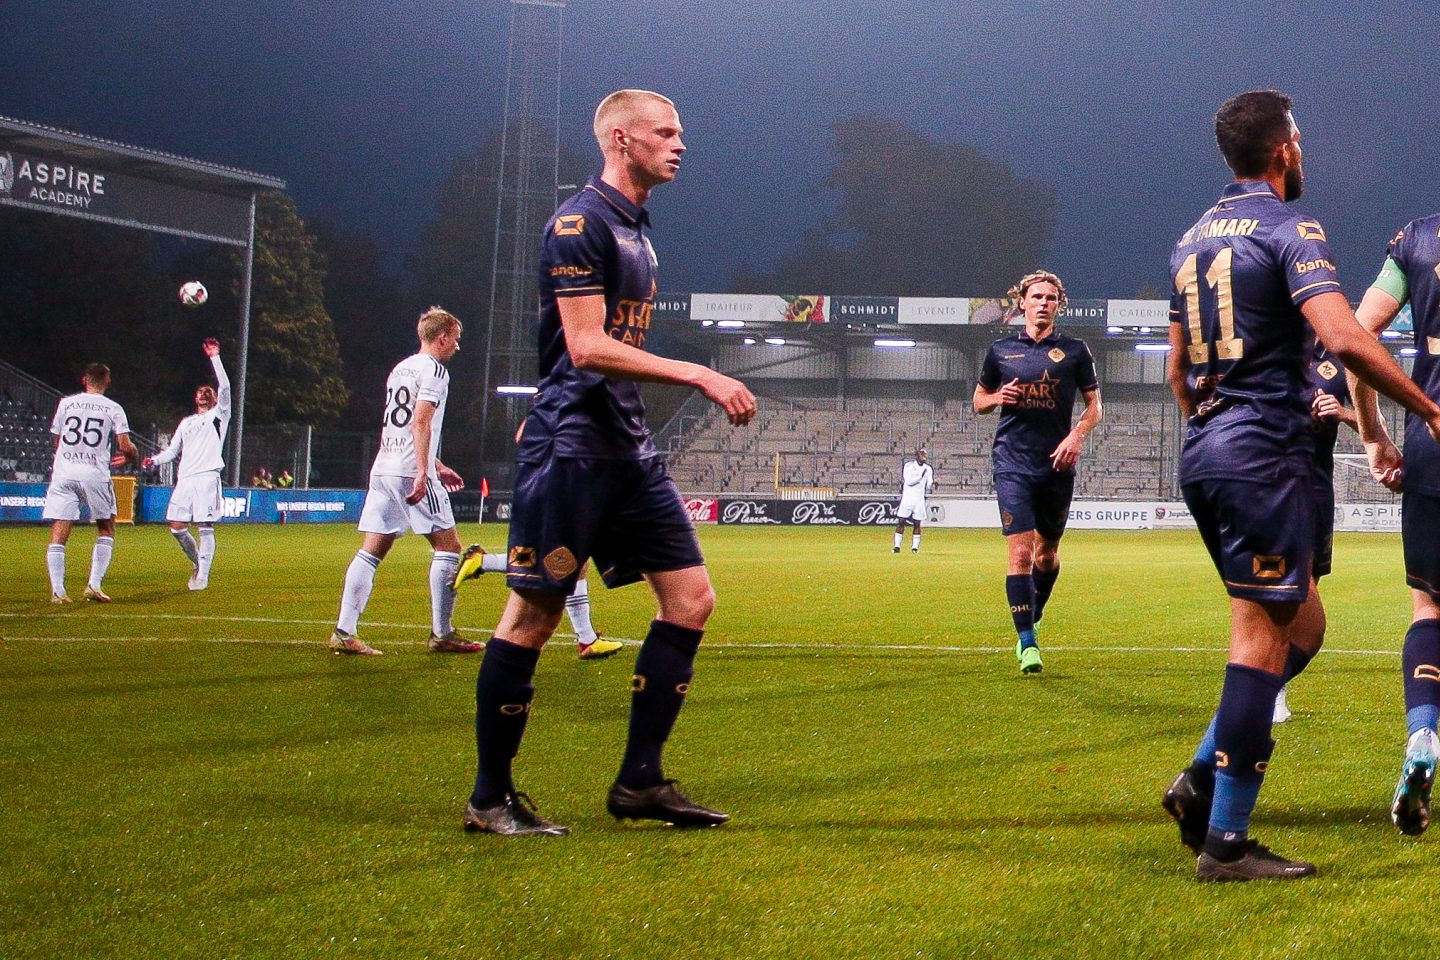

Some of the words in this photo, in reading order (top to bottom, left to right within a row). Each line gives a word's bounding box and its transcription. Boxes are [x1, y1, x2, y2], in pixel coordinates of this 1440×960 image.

[19, 160, 105, 195] ASPIRE
[30, 187, 91, 208] ACADEMY
[653, 302, 688, 312] MIDT
[841, 305, 895, 315] SCHMIDT
[918, 307, 956, 315] EVENTS
[1175, 247, 1244, 365] 11
[1058, 307, 1105, 317] CHMIDT
[1020, 383, 1052, 399] TAR
[1019, 399, 1056, 409] ASINO
[63, 416, 104, 447] 35
[63, 451, 98, 461] QATAR
[1068, 510, 1092, 520] ERS
[1096, 510, 1148, 521] GRUPPE
[1010, 604, 1032, 613] OHL
